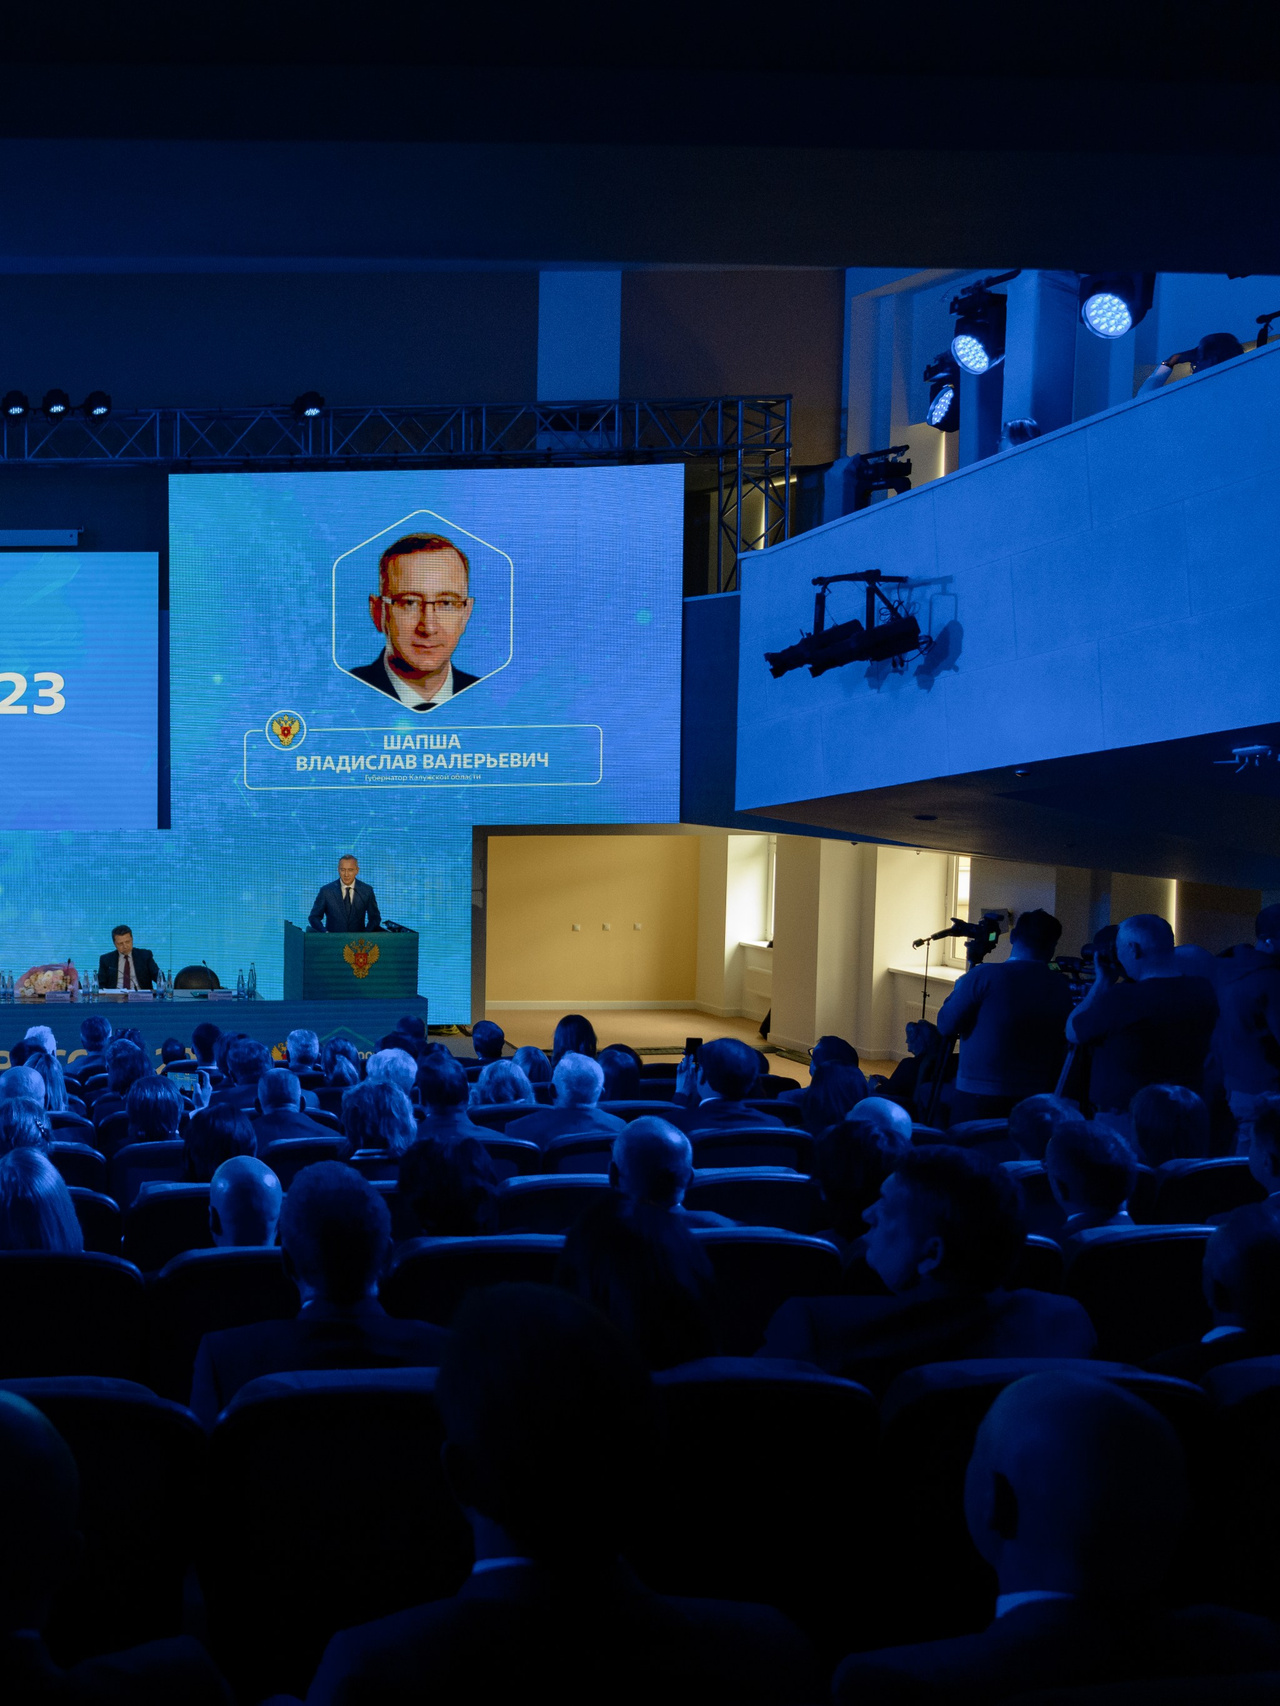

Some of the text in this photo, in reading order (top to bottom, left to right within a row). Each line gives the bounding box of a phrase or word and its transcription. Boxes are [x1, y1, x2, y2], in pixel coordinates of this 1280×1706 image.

[383, 733, 461, 750] ШАПША
[296, 752, 549, 773] ВЛАДИСЛАВ ВАЛЕРЬЕВИЧ
[364, 774, 408, 783] Губернатор
[450, 773, 482, 781] области
